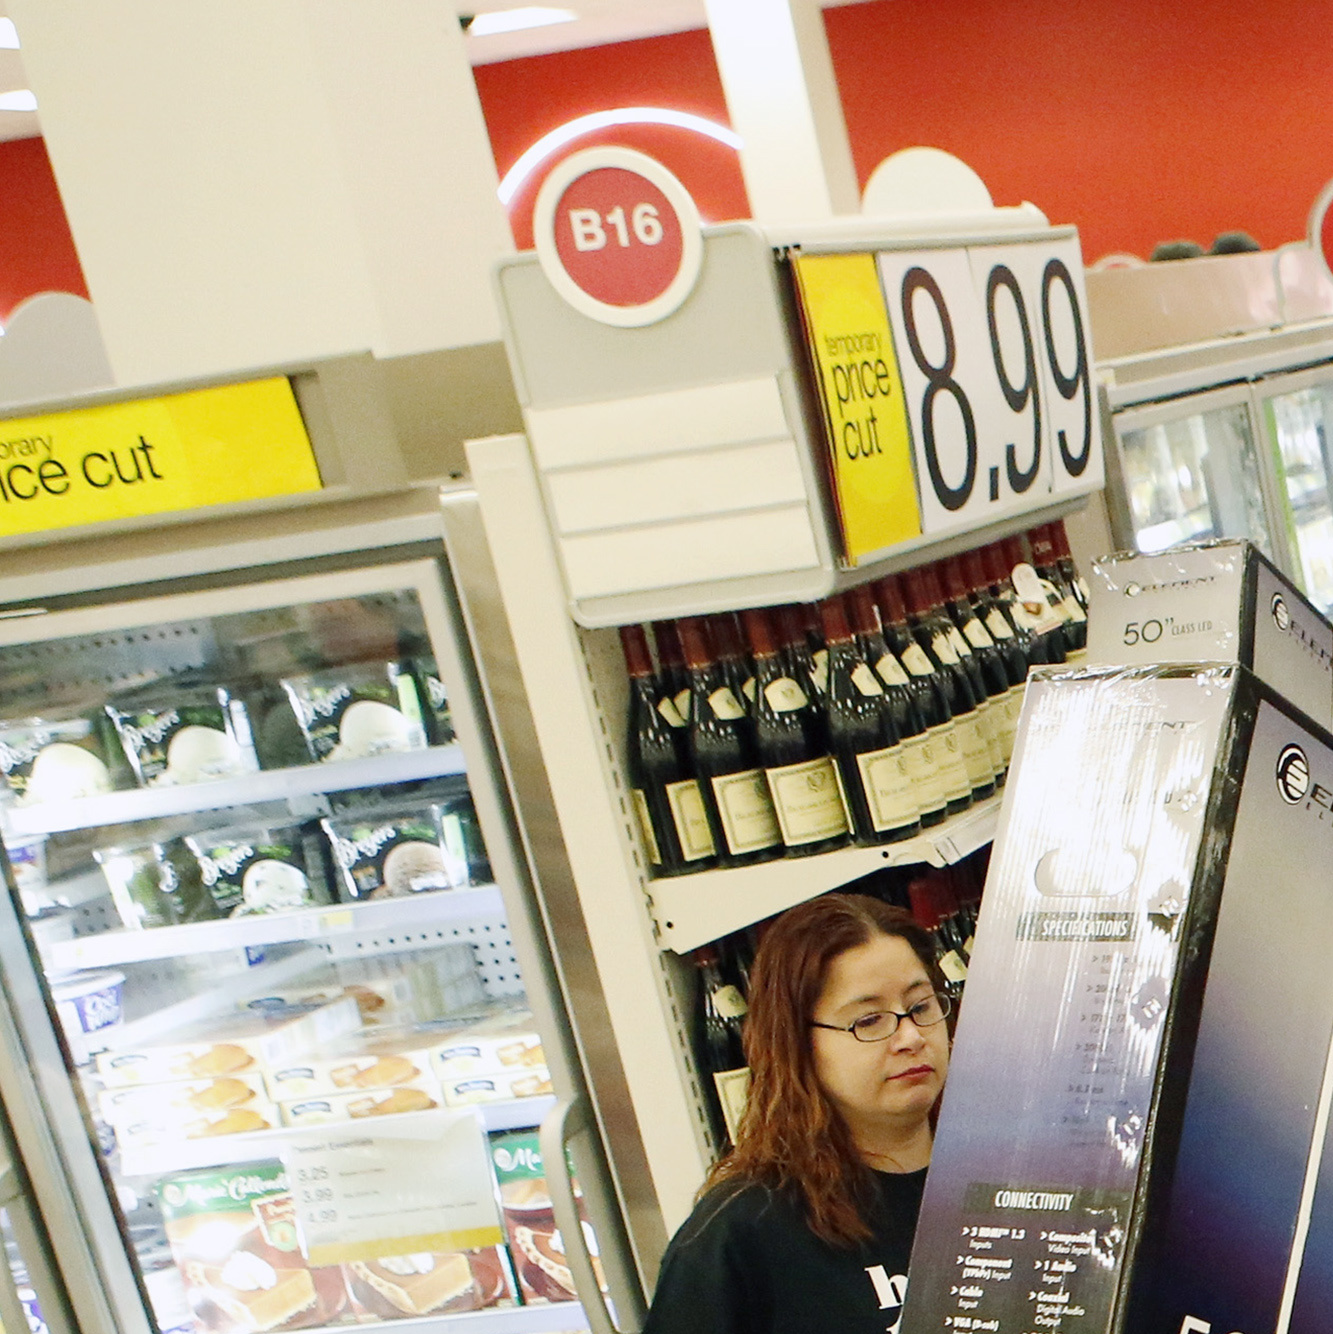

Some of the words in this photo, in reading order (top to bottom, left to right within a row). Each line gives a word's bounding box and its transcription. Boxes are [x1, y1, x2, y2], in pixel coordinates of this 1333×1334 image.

[569, 203, 663, 253] B16
[824, 331, 882, 357] temporary
[830, 354, 890, 418] price
[901, 258, 1091, 511] 8.99
[842, 413, 884, 461] cut
[82, 435, 163, 488] cut
[1171, 622, 1197, 637] CLASS
[1042, 918, 1129, 938] SPECIFICATIONS
[995, 1190, 1073, 1211] CONNECTIVITY
